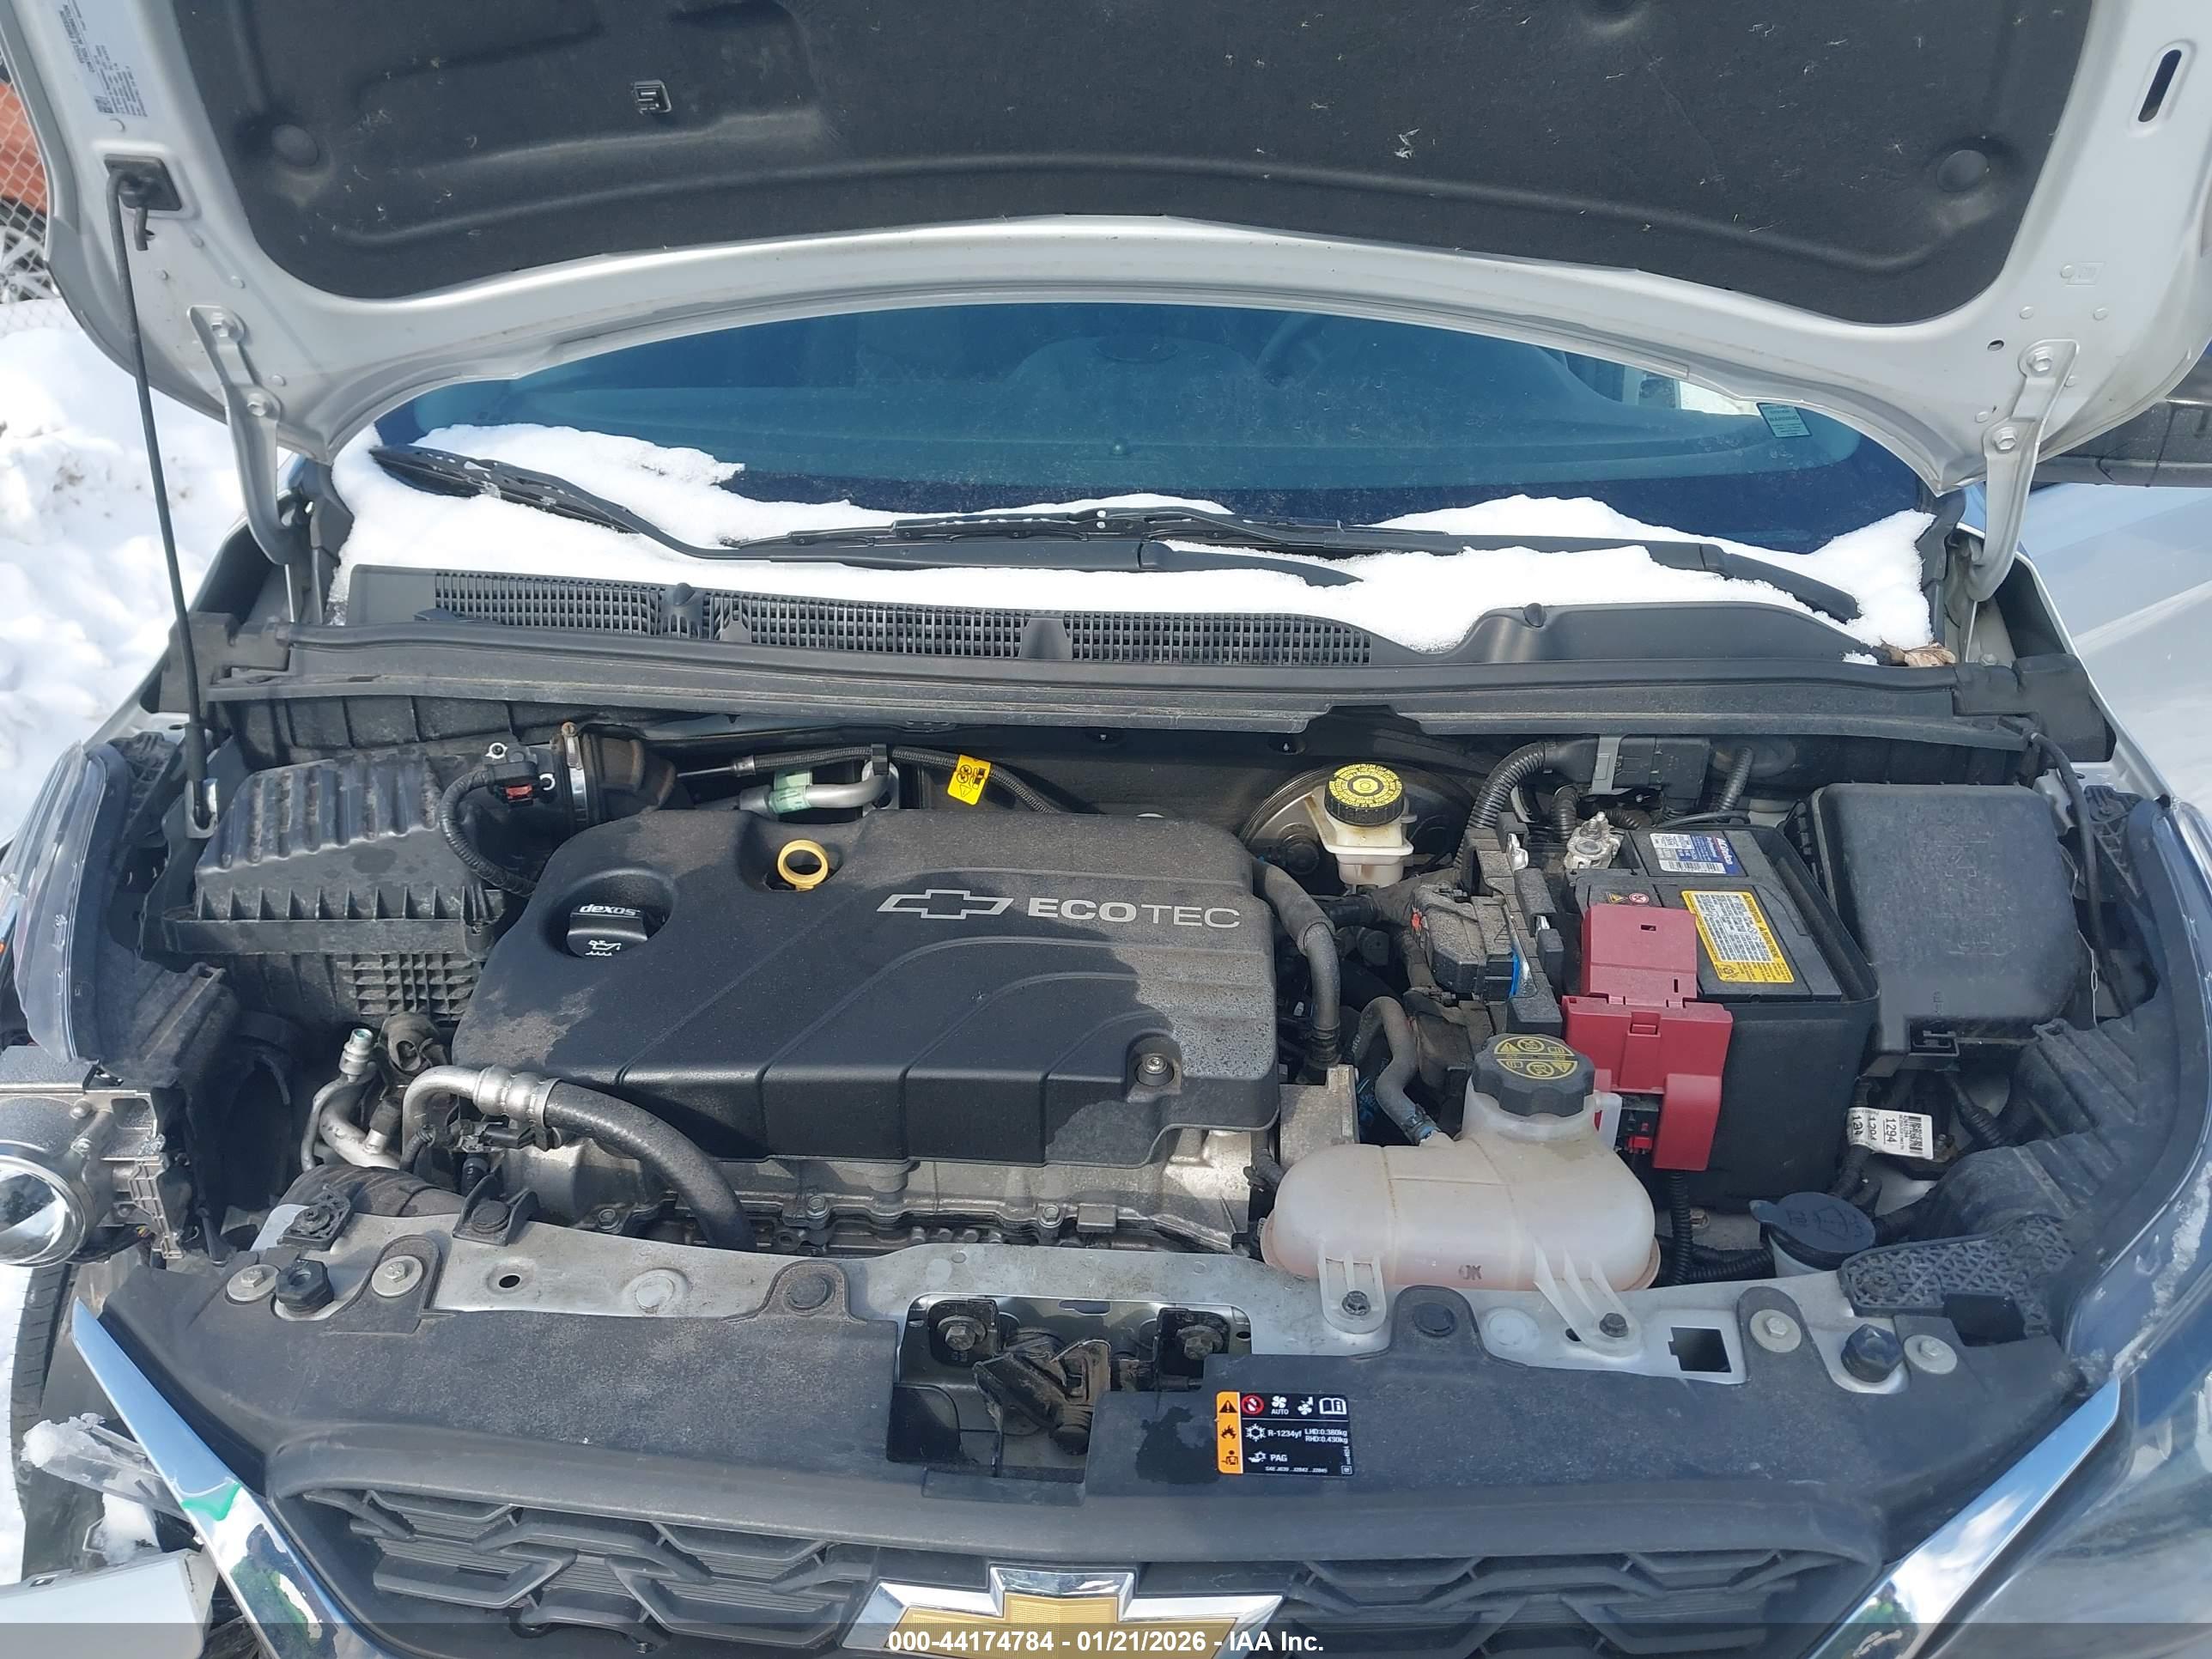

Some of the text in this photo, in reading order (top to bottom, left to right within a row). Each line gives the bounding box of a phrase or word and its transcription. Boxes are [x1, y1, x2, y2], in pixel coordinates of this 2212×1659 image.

[580, 903, 636, 916] dexos
[1029, 897, 1241, 929] ECOTEC
[1886, 1118, 1898, 1143] 1294
[1267, 1430, 1302, 1438] R-1234yf
[1270, 1454, 1288, 1462] PAG
